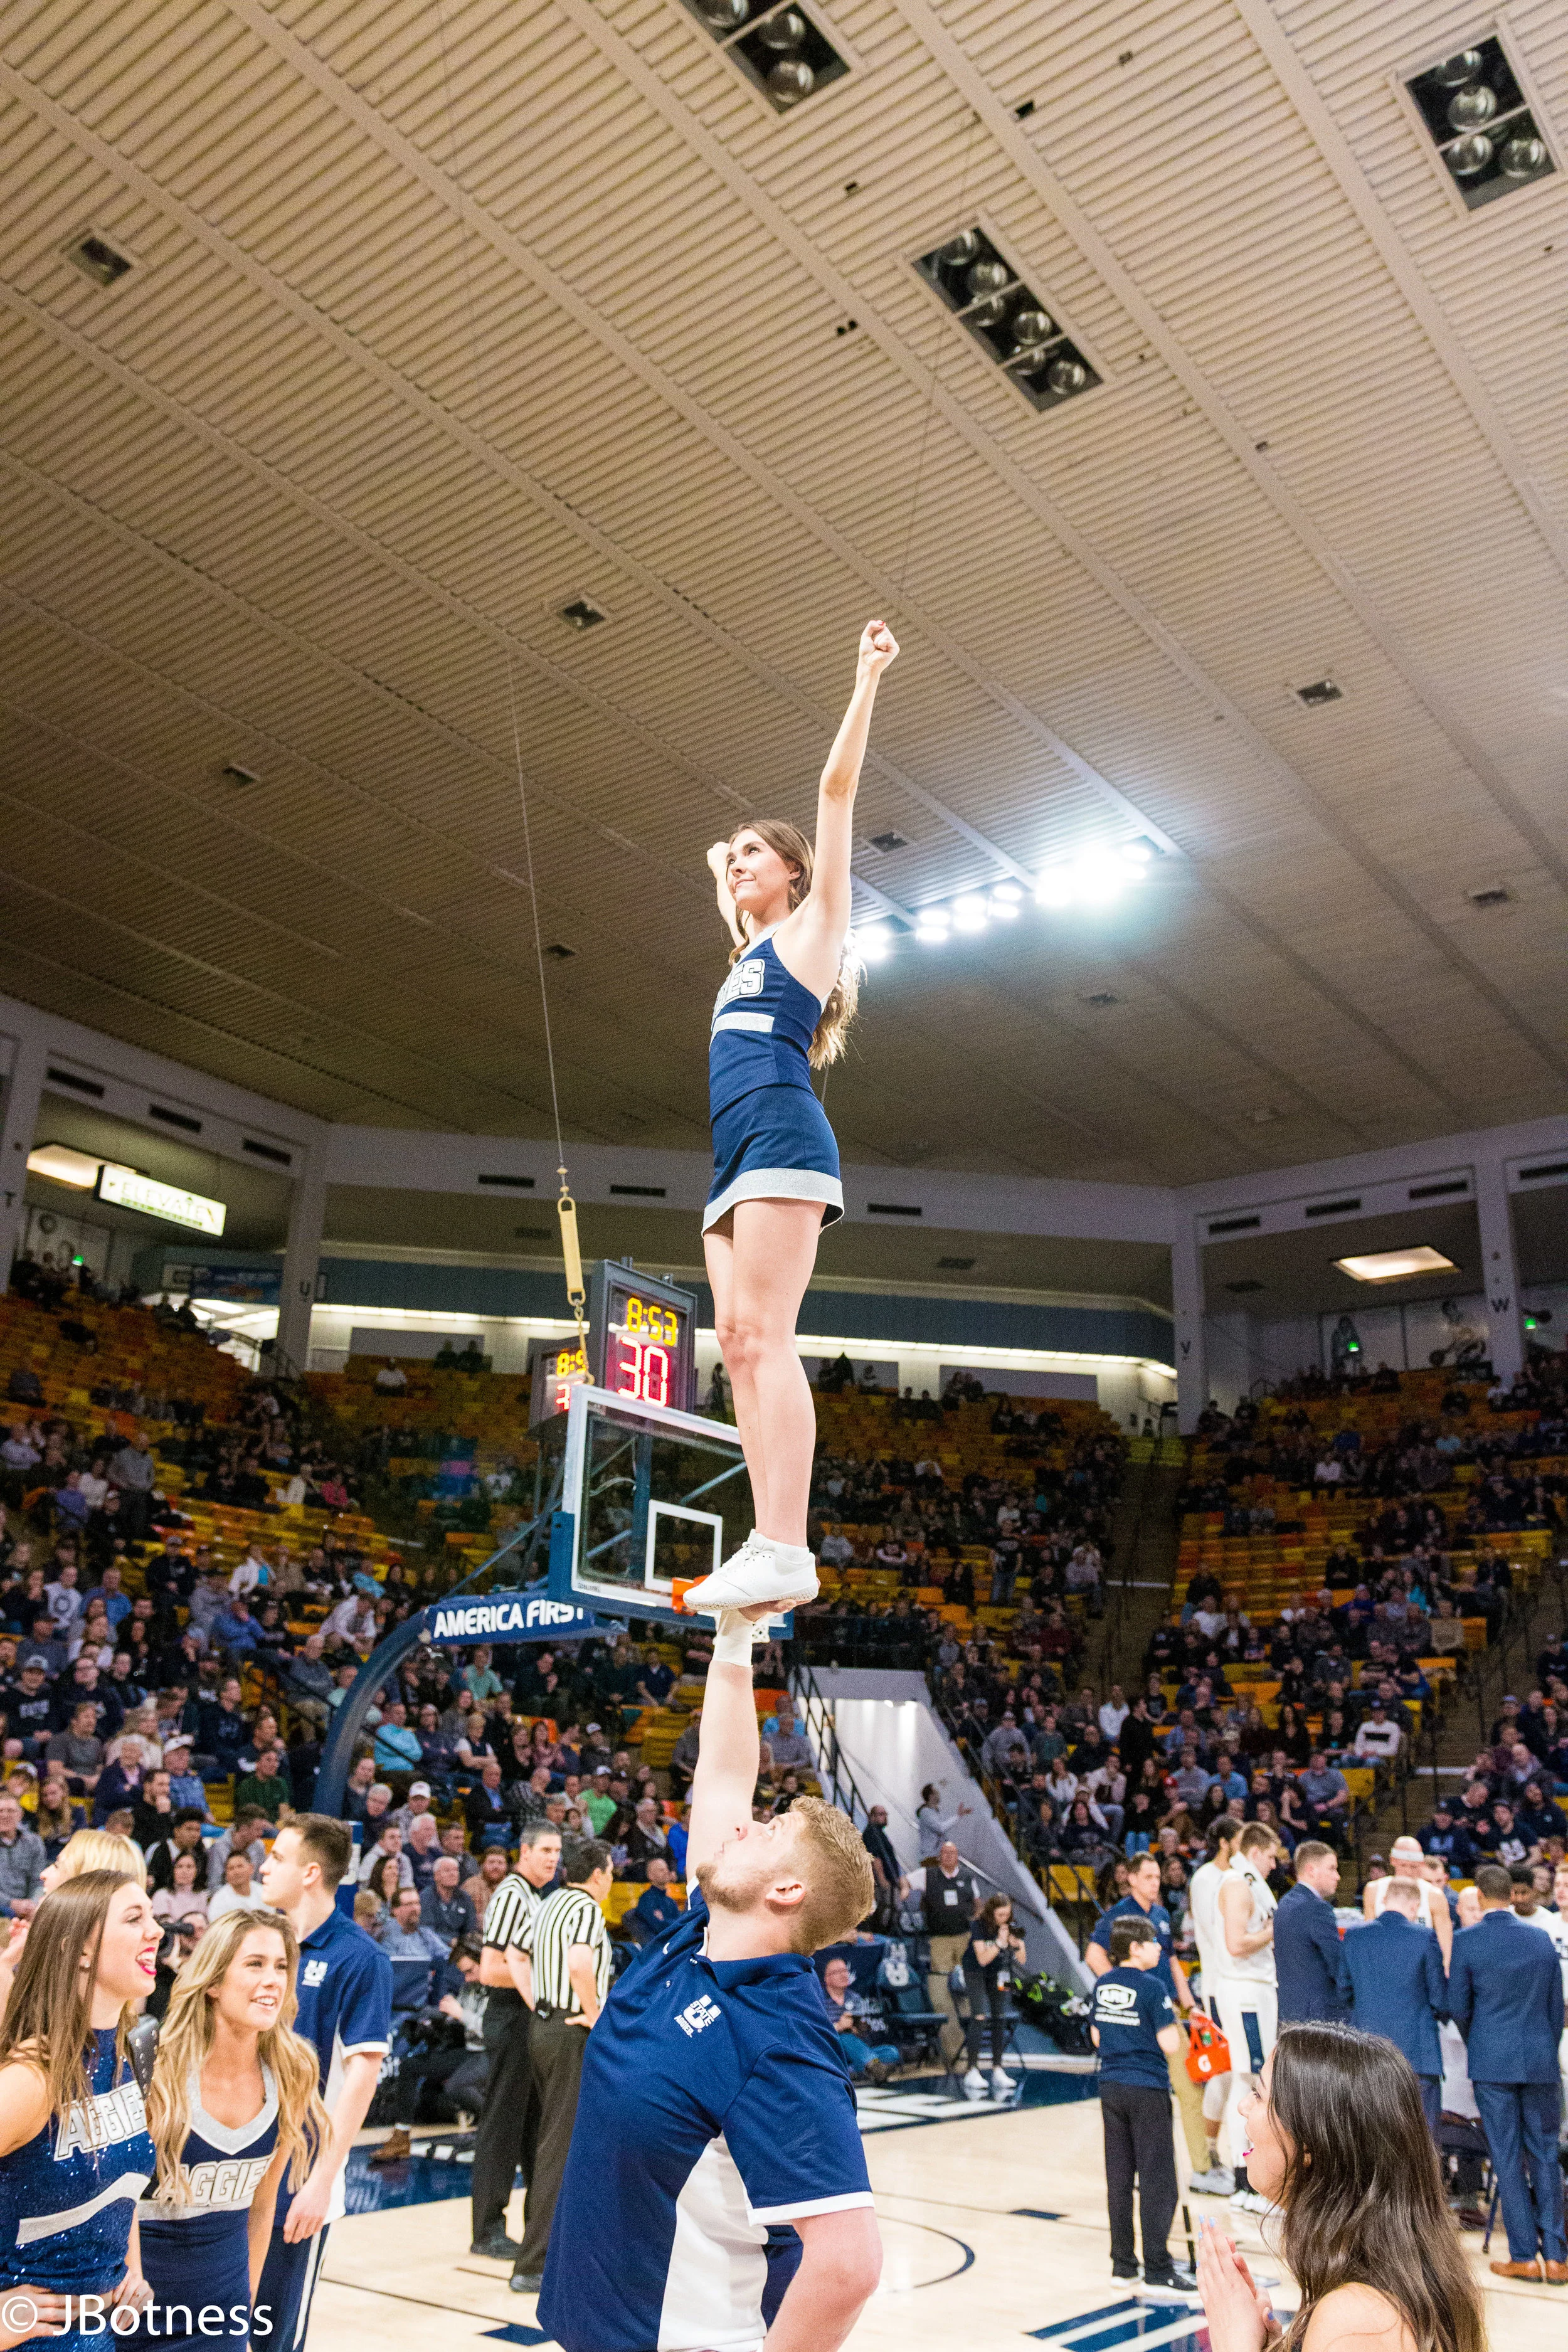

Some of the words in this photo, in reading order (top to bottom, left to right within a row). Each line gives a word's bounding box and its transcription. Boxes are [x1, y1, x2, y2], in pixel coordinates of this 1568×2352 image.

[1491, 1298, 1510, 1312] W
[627, 1296, 678, 1347] 8:53
[1180, 1340, 1191, 1353] V
[556, 1349, 587, 1378] 8:5
[618, 1335, 669, 1407] 30
[433, 1602, 525, 1638] AMERICA
[689, 2000, 714, 2027] STATE
[1197, 2054, 1212, 2073] G
[54, 2080, 147, 2161] AGGIE
[152, 2150, 276, 2207] AGGIE
